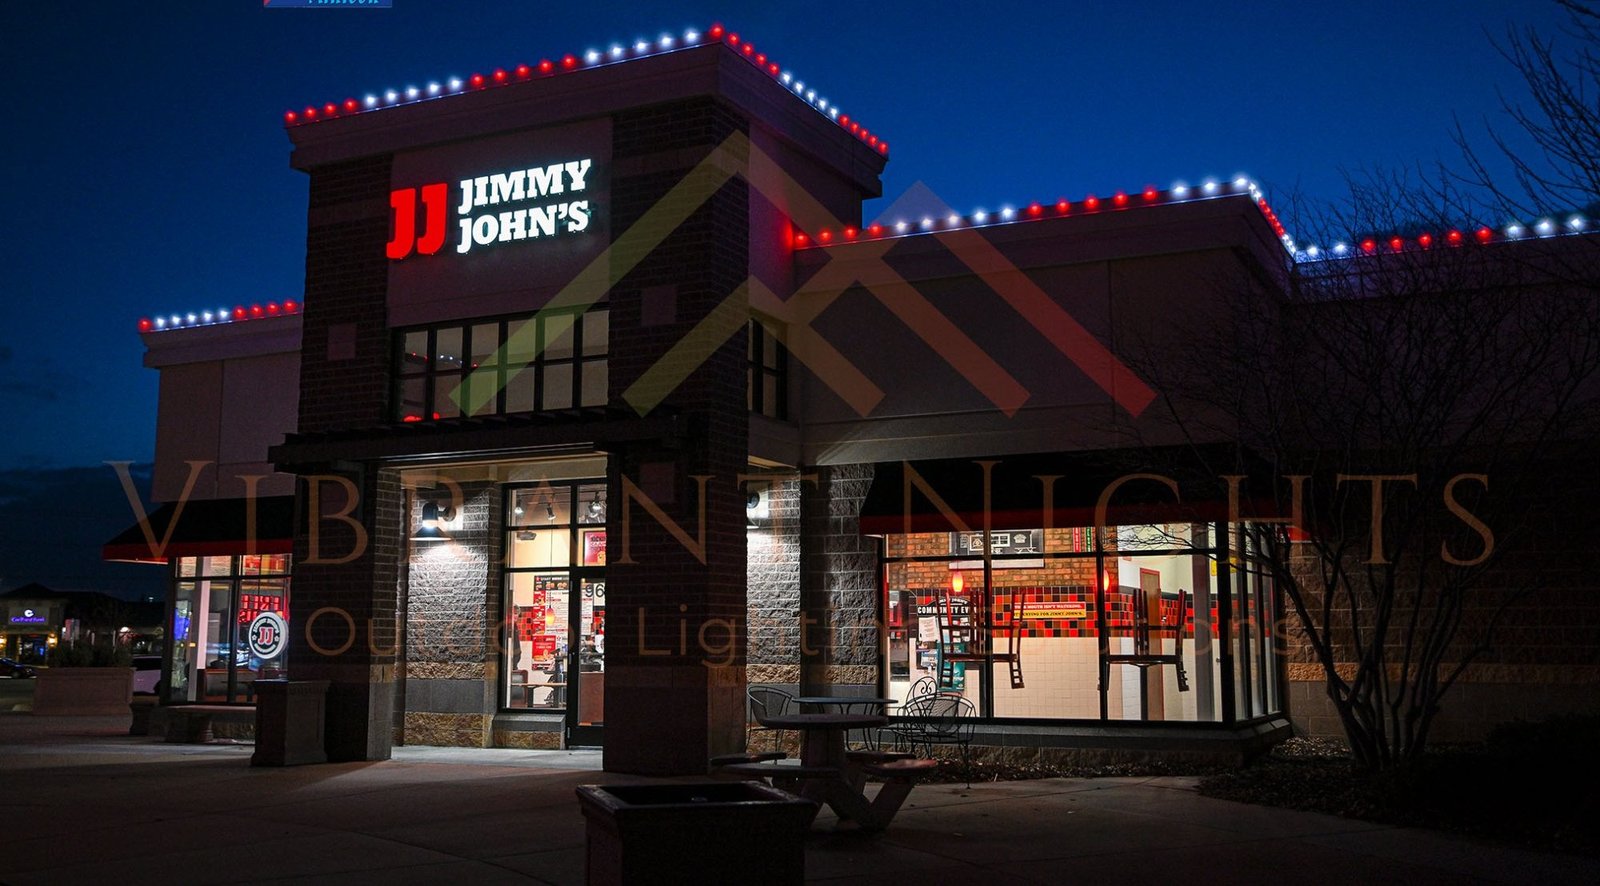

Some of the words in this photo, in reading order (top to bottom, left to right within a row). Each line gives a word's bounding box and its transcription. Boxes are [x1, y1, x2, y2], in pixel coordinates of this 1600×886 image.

[458, 158, 591, 215] JIMMY
[386, 182, 448, 260] JJ
[457, 199, 589, 254] JOHN'S
[257, 627, 274, 645] JJ
[917, 606, 959, 614] COMMNTY
